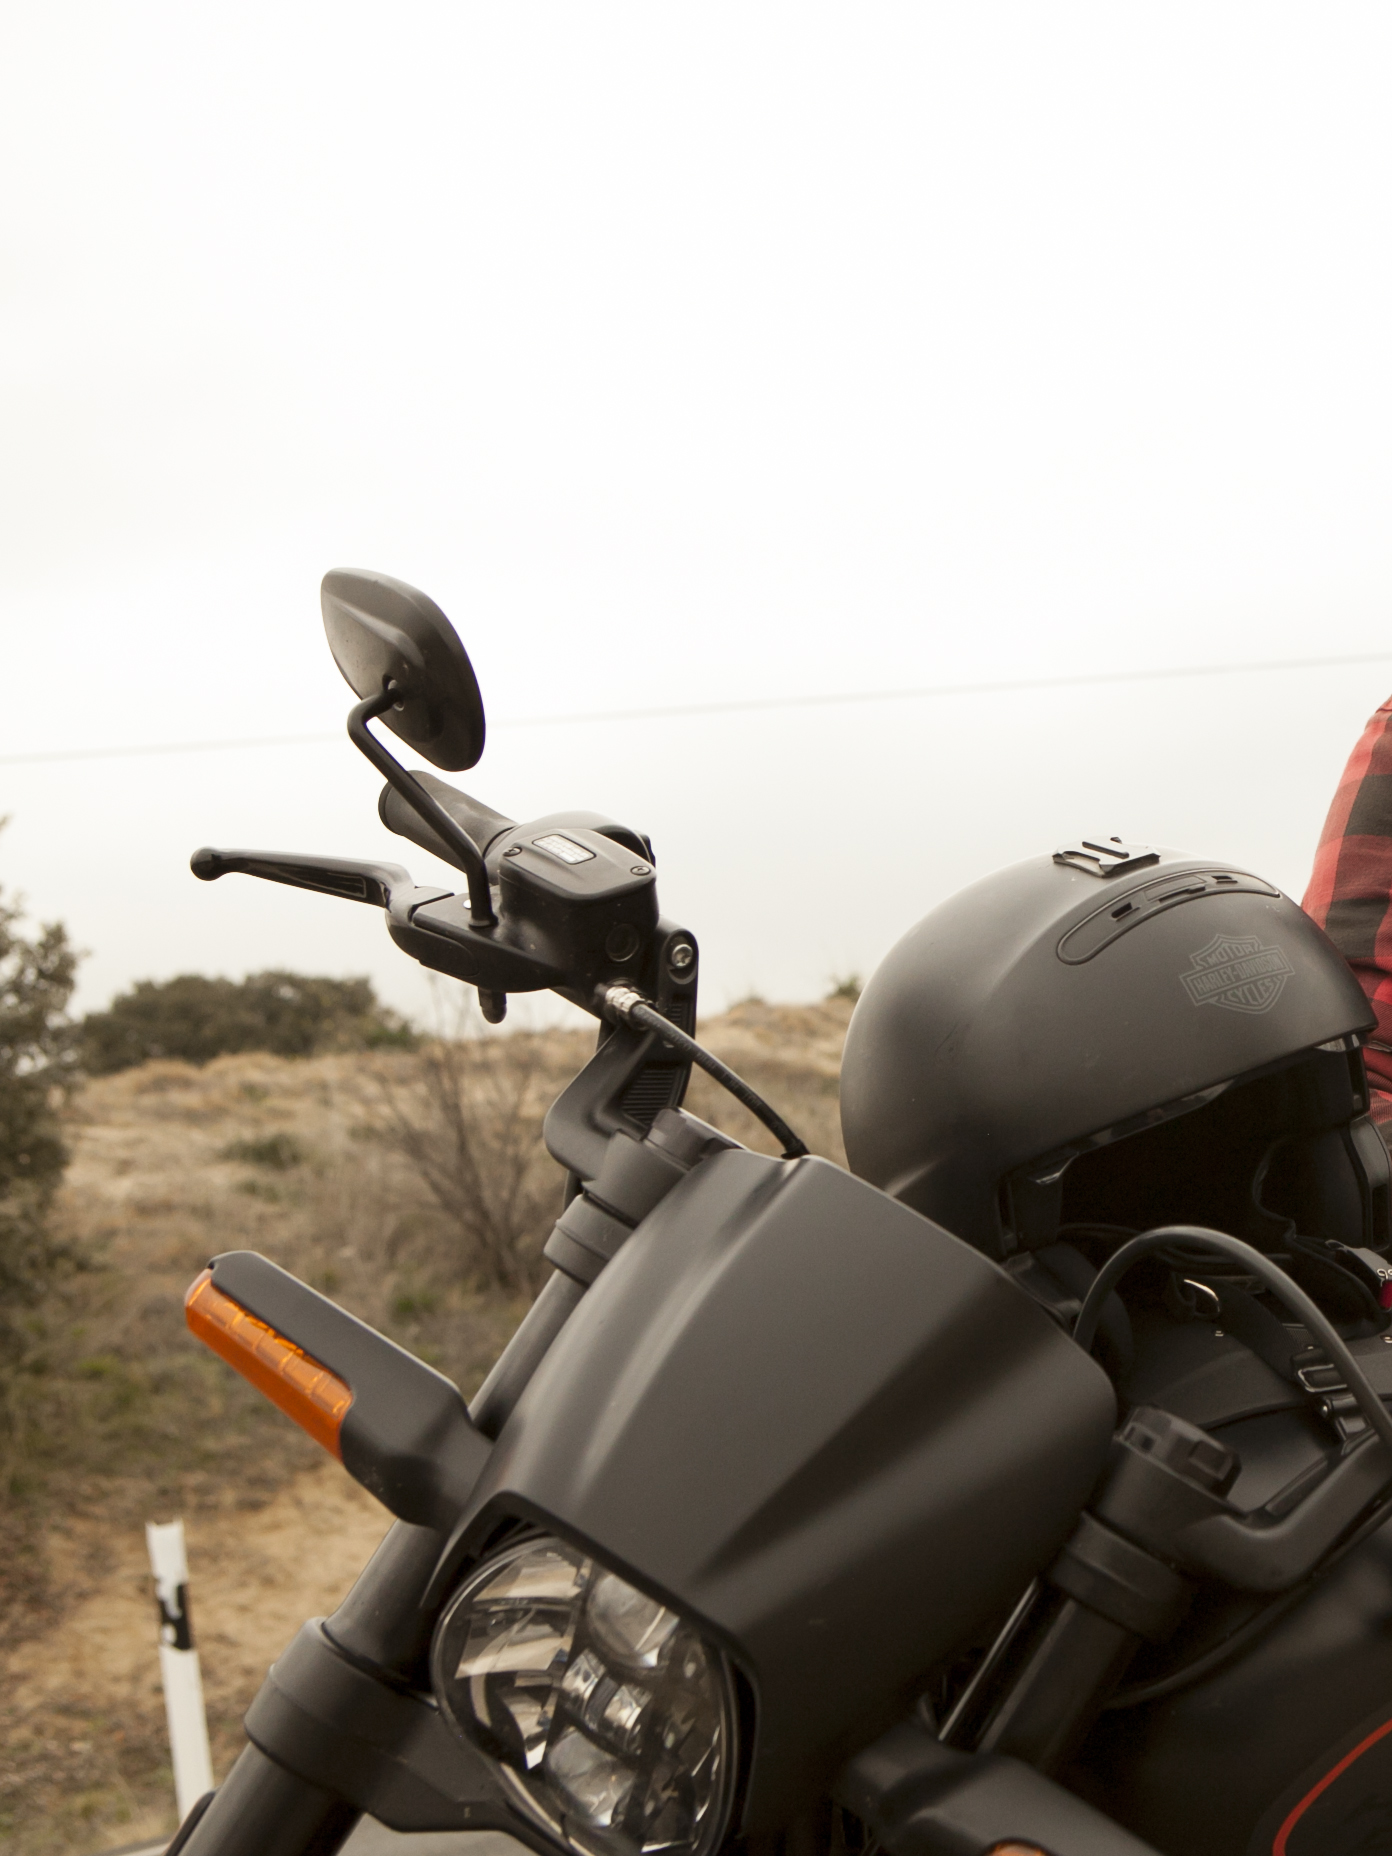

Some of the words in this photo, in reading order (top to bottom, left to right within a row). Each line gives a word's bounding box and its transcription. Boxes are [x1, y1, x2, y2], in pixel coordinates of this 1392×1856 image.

[1206, 943, 1256, 967] MOTOR
[1193, 953, 1285, 995] HARLEY-DAVIDSON
[1226, 978, 1275, 1005] CYCLES
